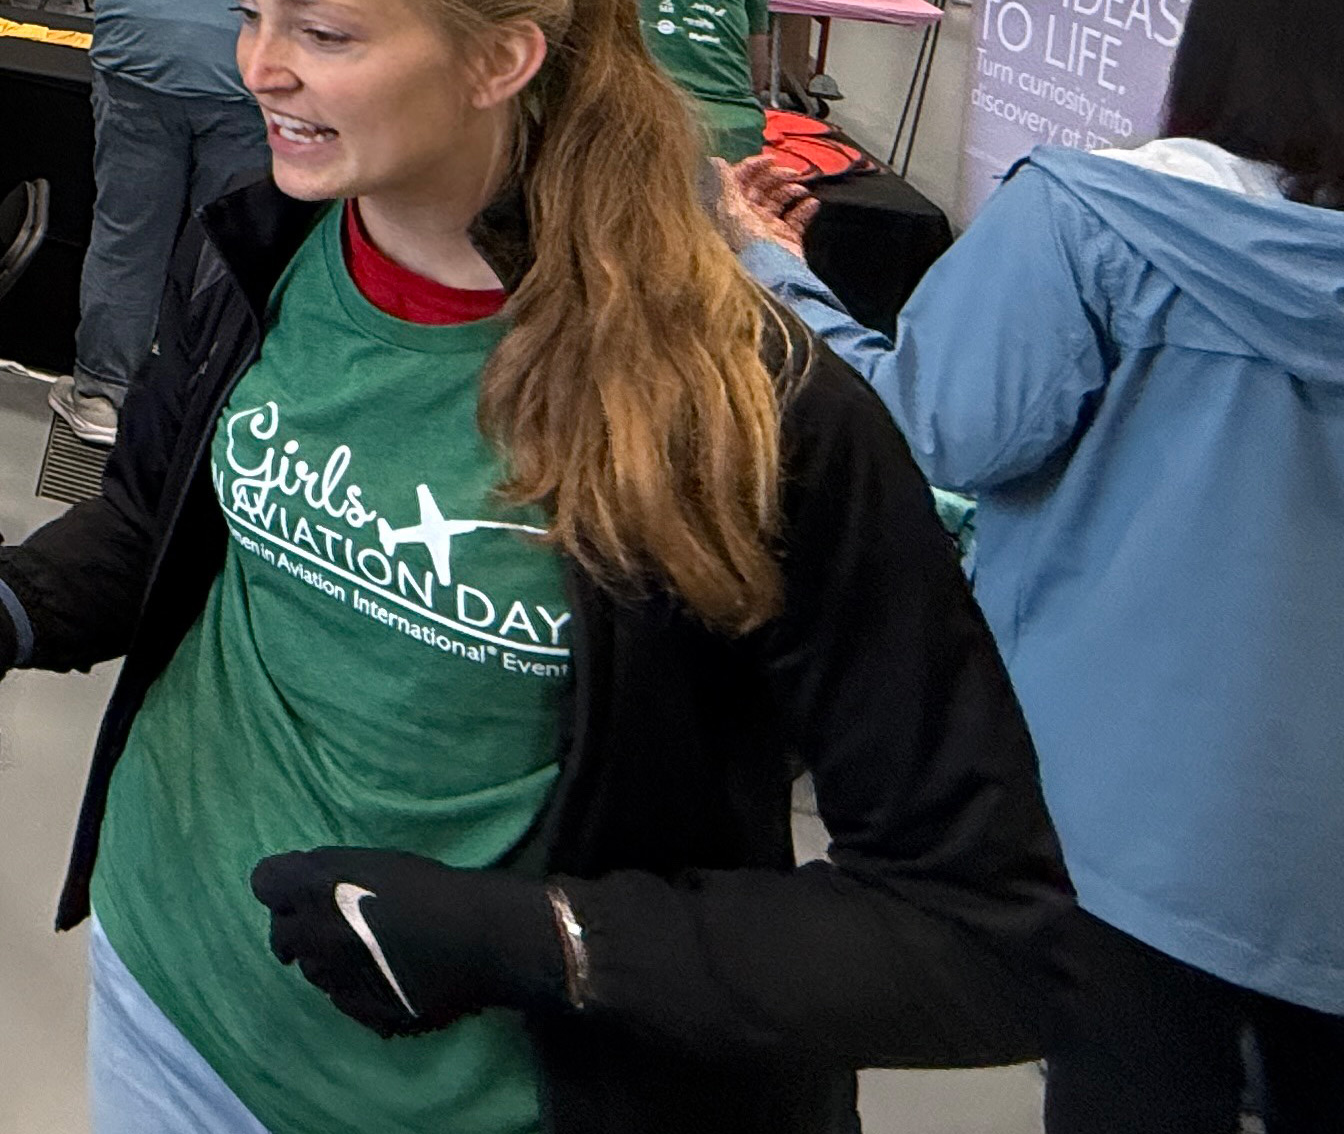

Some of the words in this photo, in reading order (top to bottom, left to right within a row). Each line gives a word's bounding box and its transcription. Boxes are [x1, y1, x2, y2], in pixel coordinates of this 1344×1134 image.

[976, 47, 1013, 84] Turn
[1018, 69, 1095, 127] curiosity
[1099, 97, 1133, 138] into
[1045, 14, 1126, 95] LIFE.
[971, 82, 1058, 146] discovery
[1062, 127, 1081, 149] at
[226, 401, 376, 532] Girls
[232, 480, 434, 608] AVIATION
[455, 582, 572, 646] DAY
[260, 543, 275, 565] in
[276, 552, 346, 603] Aviation
